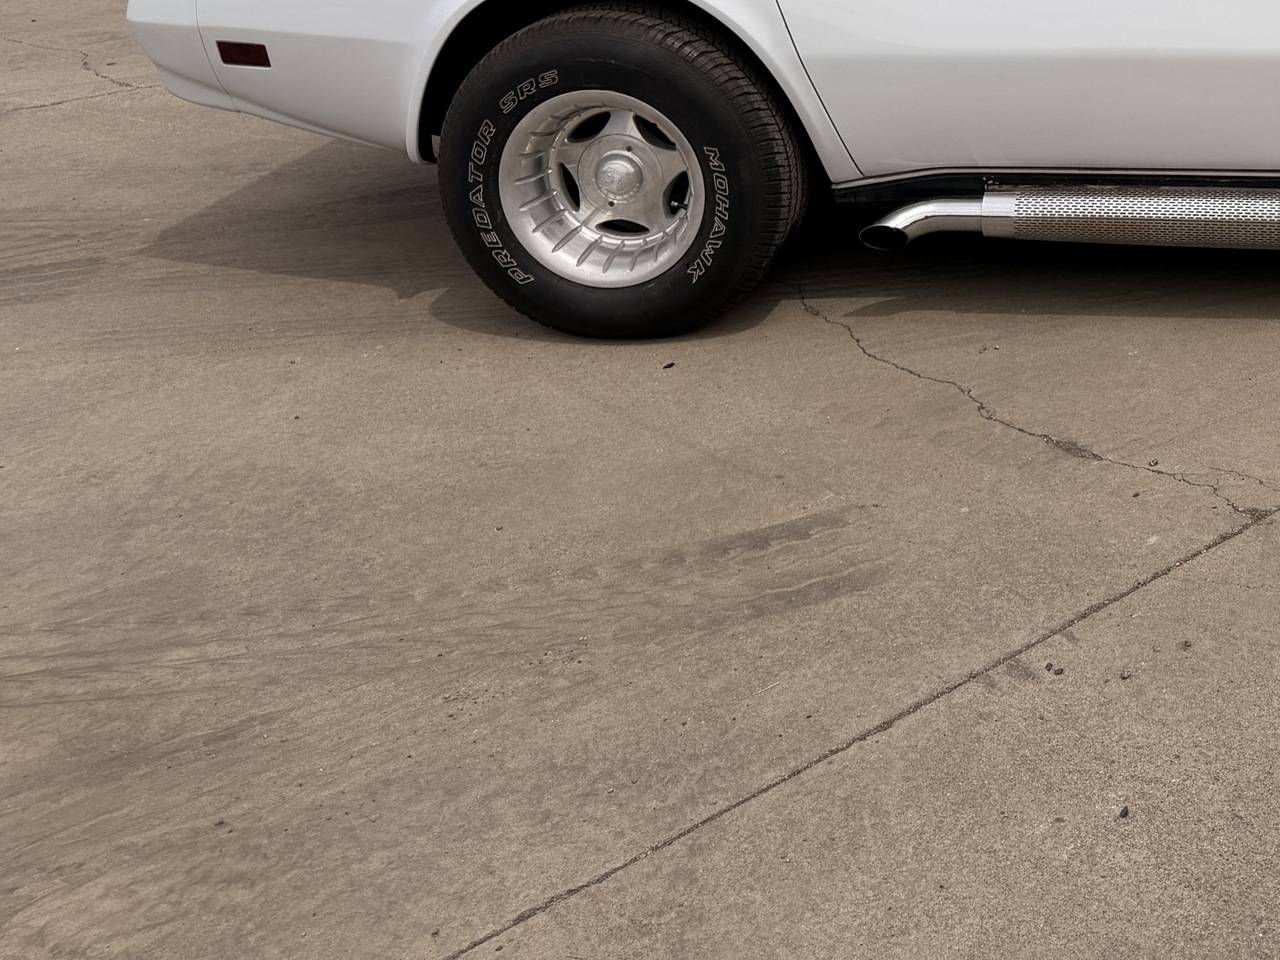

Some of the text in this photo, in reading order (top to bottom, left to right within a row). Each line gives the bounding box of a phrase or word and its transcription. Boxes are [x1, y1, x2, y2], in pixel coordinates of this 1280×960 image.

[468, 69, 560, 286] PREDATOR SRS
[686, 145, 730, 285] MOHAWK
